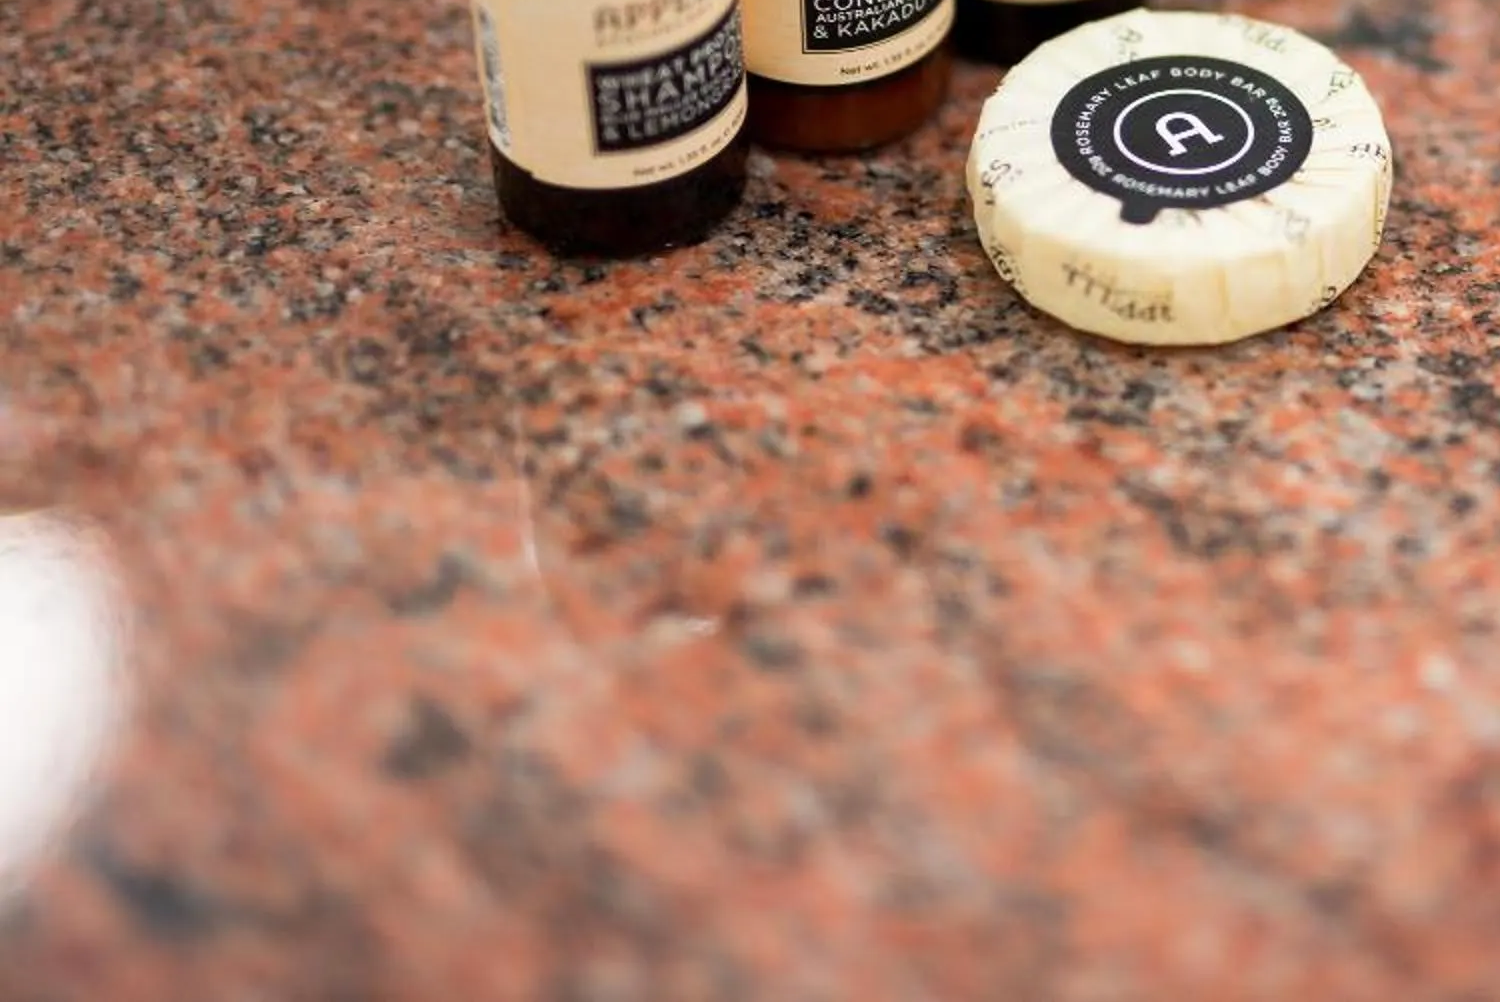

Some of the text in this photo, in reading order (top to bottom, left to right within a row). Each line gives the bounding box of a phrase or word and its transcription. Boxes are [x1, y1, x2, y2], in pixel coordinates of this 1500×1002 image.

[813, 24, 829, 39] &
[1075, 87, 1112, 155] ROSEMARY
[1113, 69, 1160, 90] LEAF
[1169, 66, 1224, 80] BODY
[1229, 76, 1267, 98] BAR
[1155, 111, 1224, 157] A
[1257, 145, 1289, 177] BODY
[1277, 119, 1293, 144] BAR
